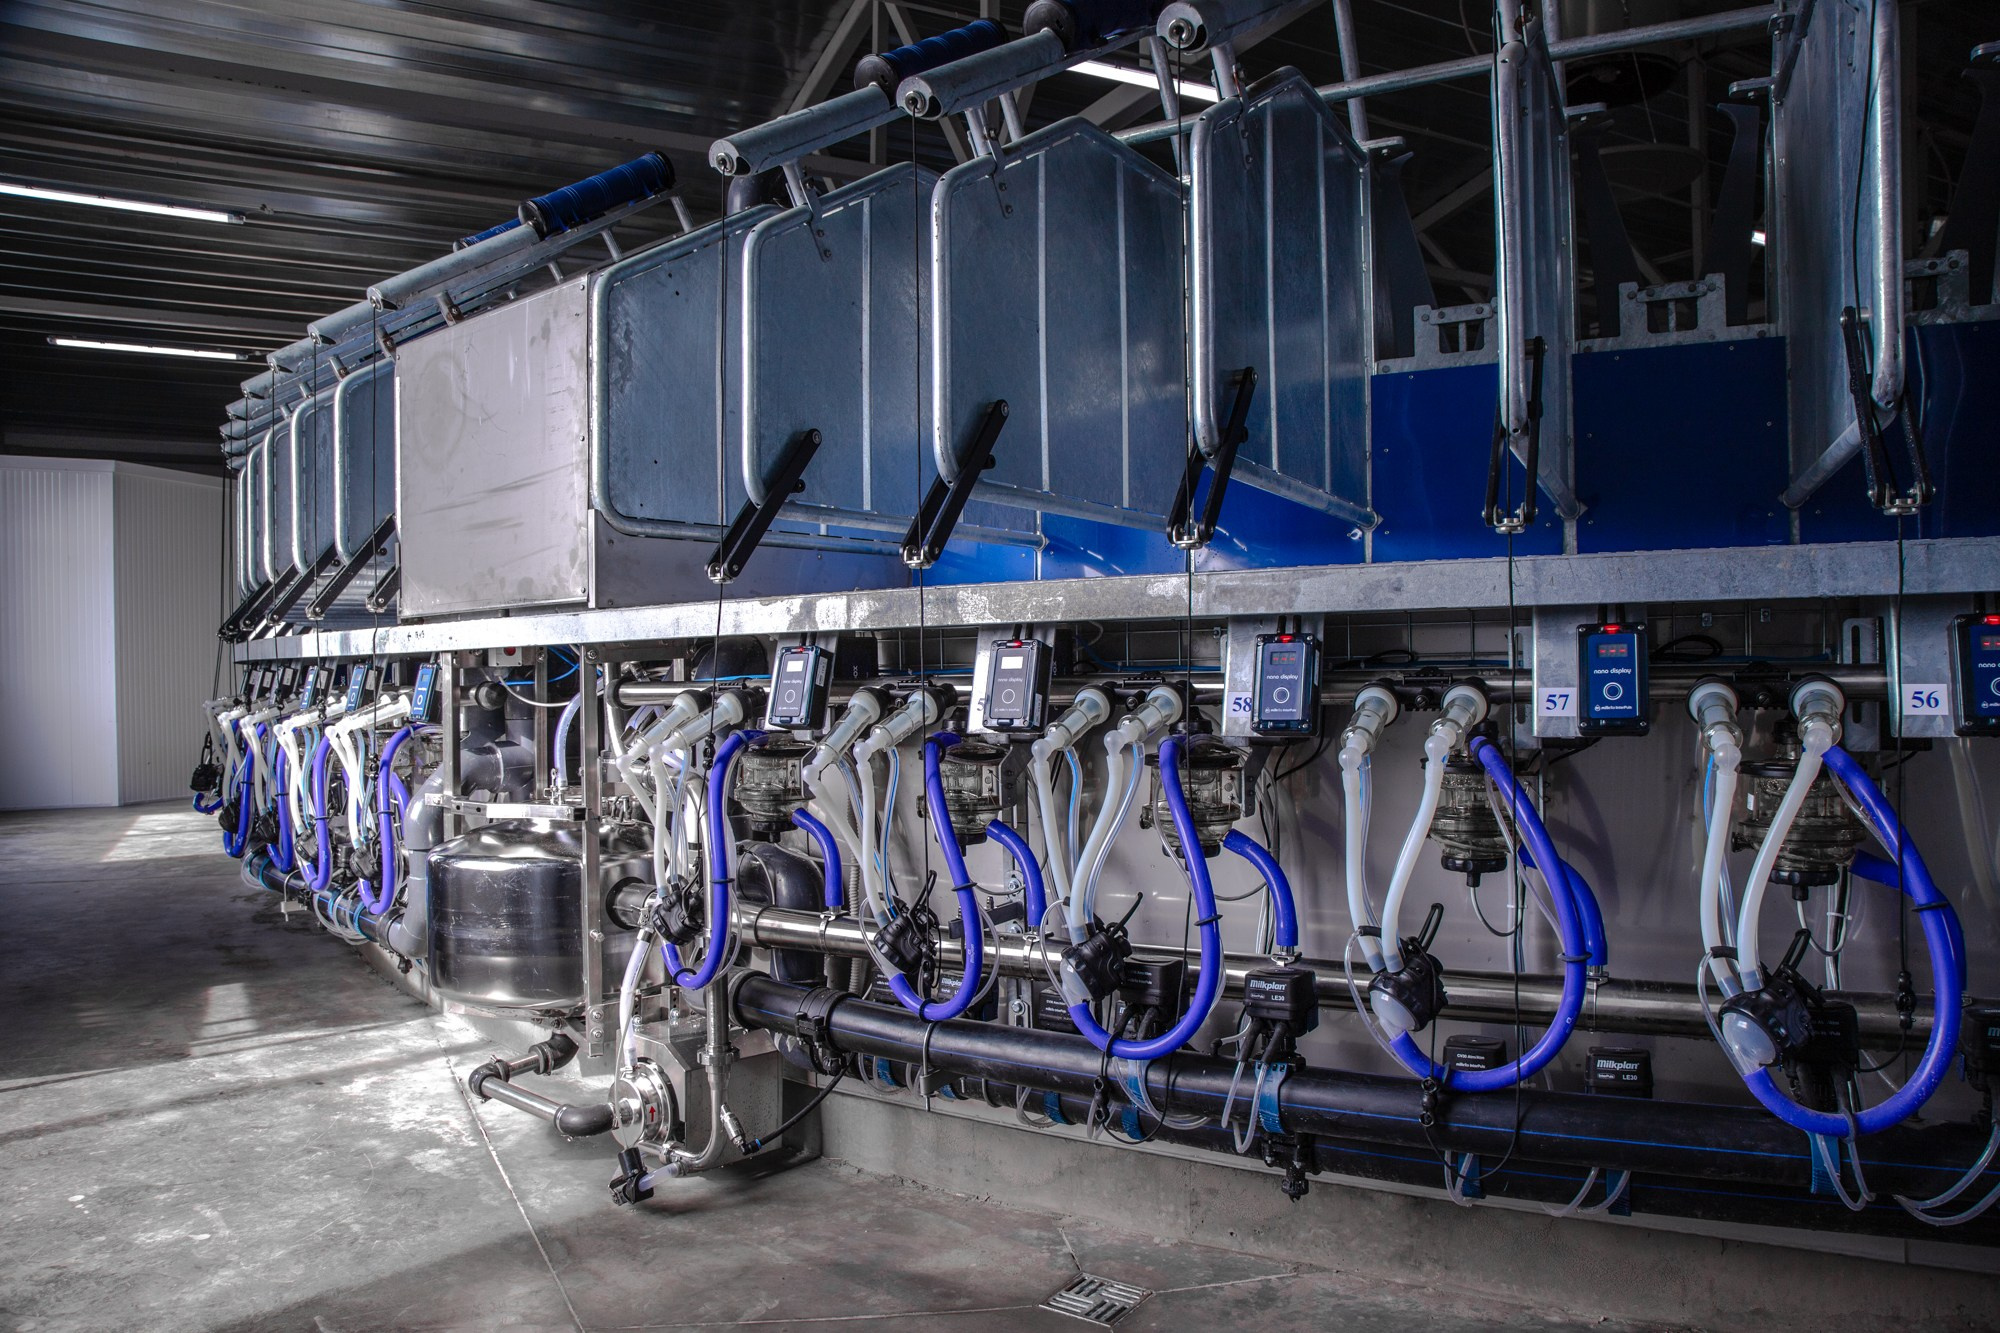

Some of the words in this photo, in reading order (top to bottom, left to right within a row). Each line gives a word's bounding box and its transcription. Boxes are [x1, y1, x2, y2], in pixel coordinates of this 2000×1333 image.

[1609, 667, 1632, 675] display
[1232, 697, 1252, 712] 58
[1545, 694, 1570, 711] 57
[1911, 691, 1940, 708] 56
[1250, 979, 1286, 991] Milkplan
[1596, 1059, 1638, 1070] Milkplan
